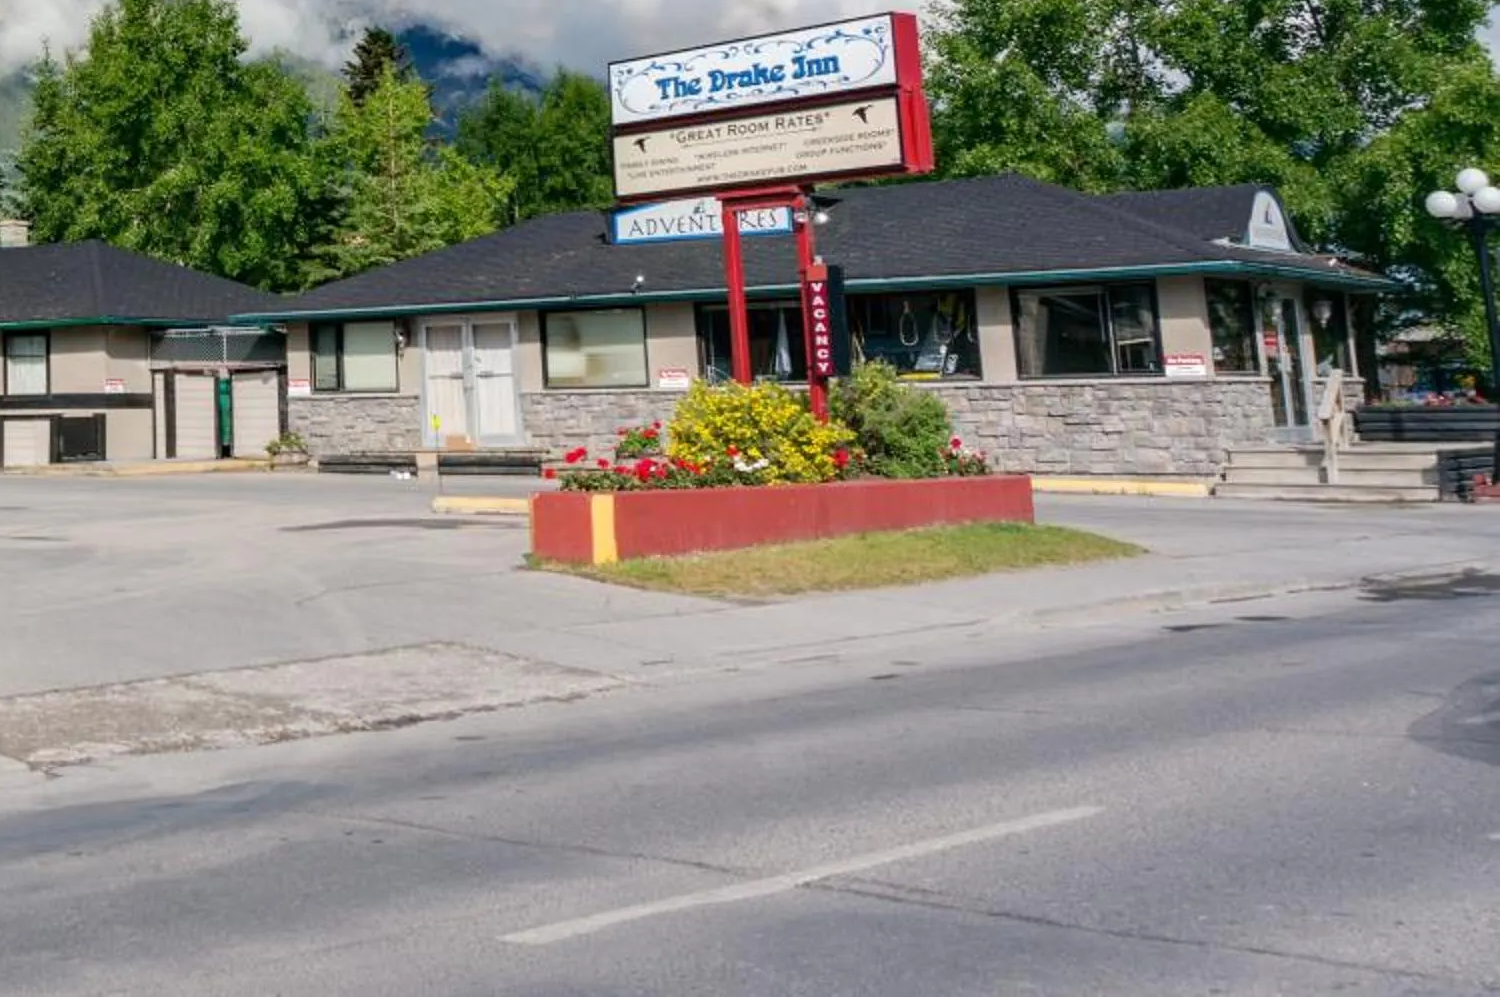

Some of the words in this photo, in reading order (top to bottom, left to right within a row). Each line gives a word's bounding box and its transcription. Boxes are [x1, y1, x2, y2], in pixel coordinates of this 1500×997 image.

[655, 76, 701, 100] The
[707, 63, 786, 93] Drake
[791, 55, 840, 79] Inn
[727, 121, 769, 137] ROOM
[628, 210, 778, 238] ADVENTRES
[810, 282, 830, 373] VACANCY
